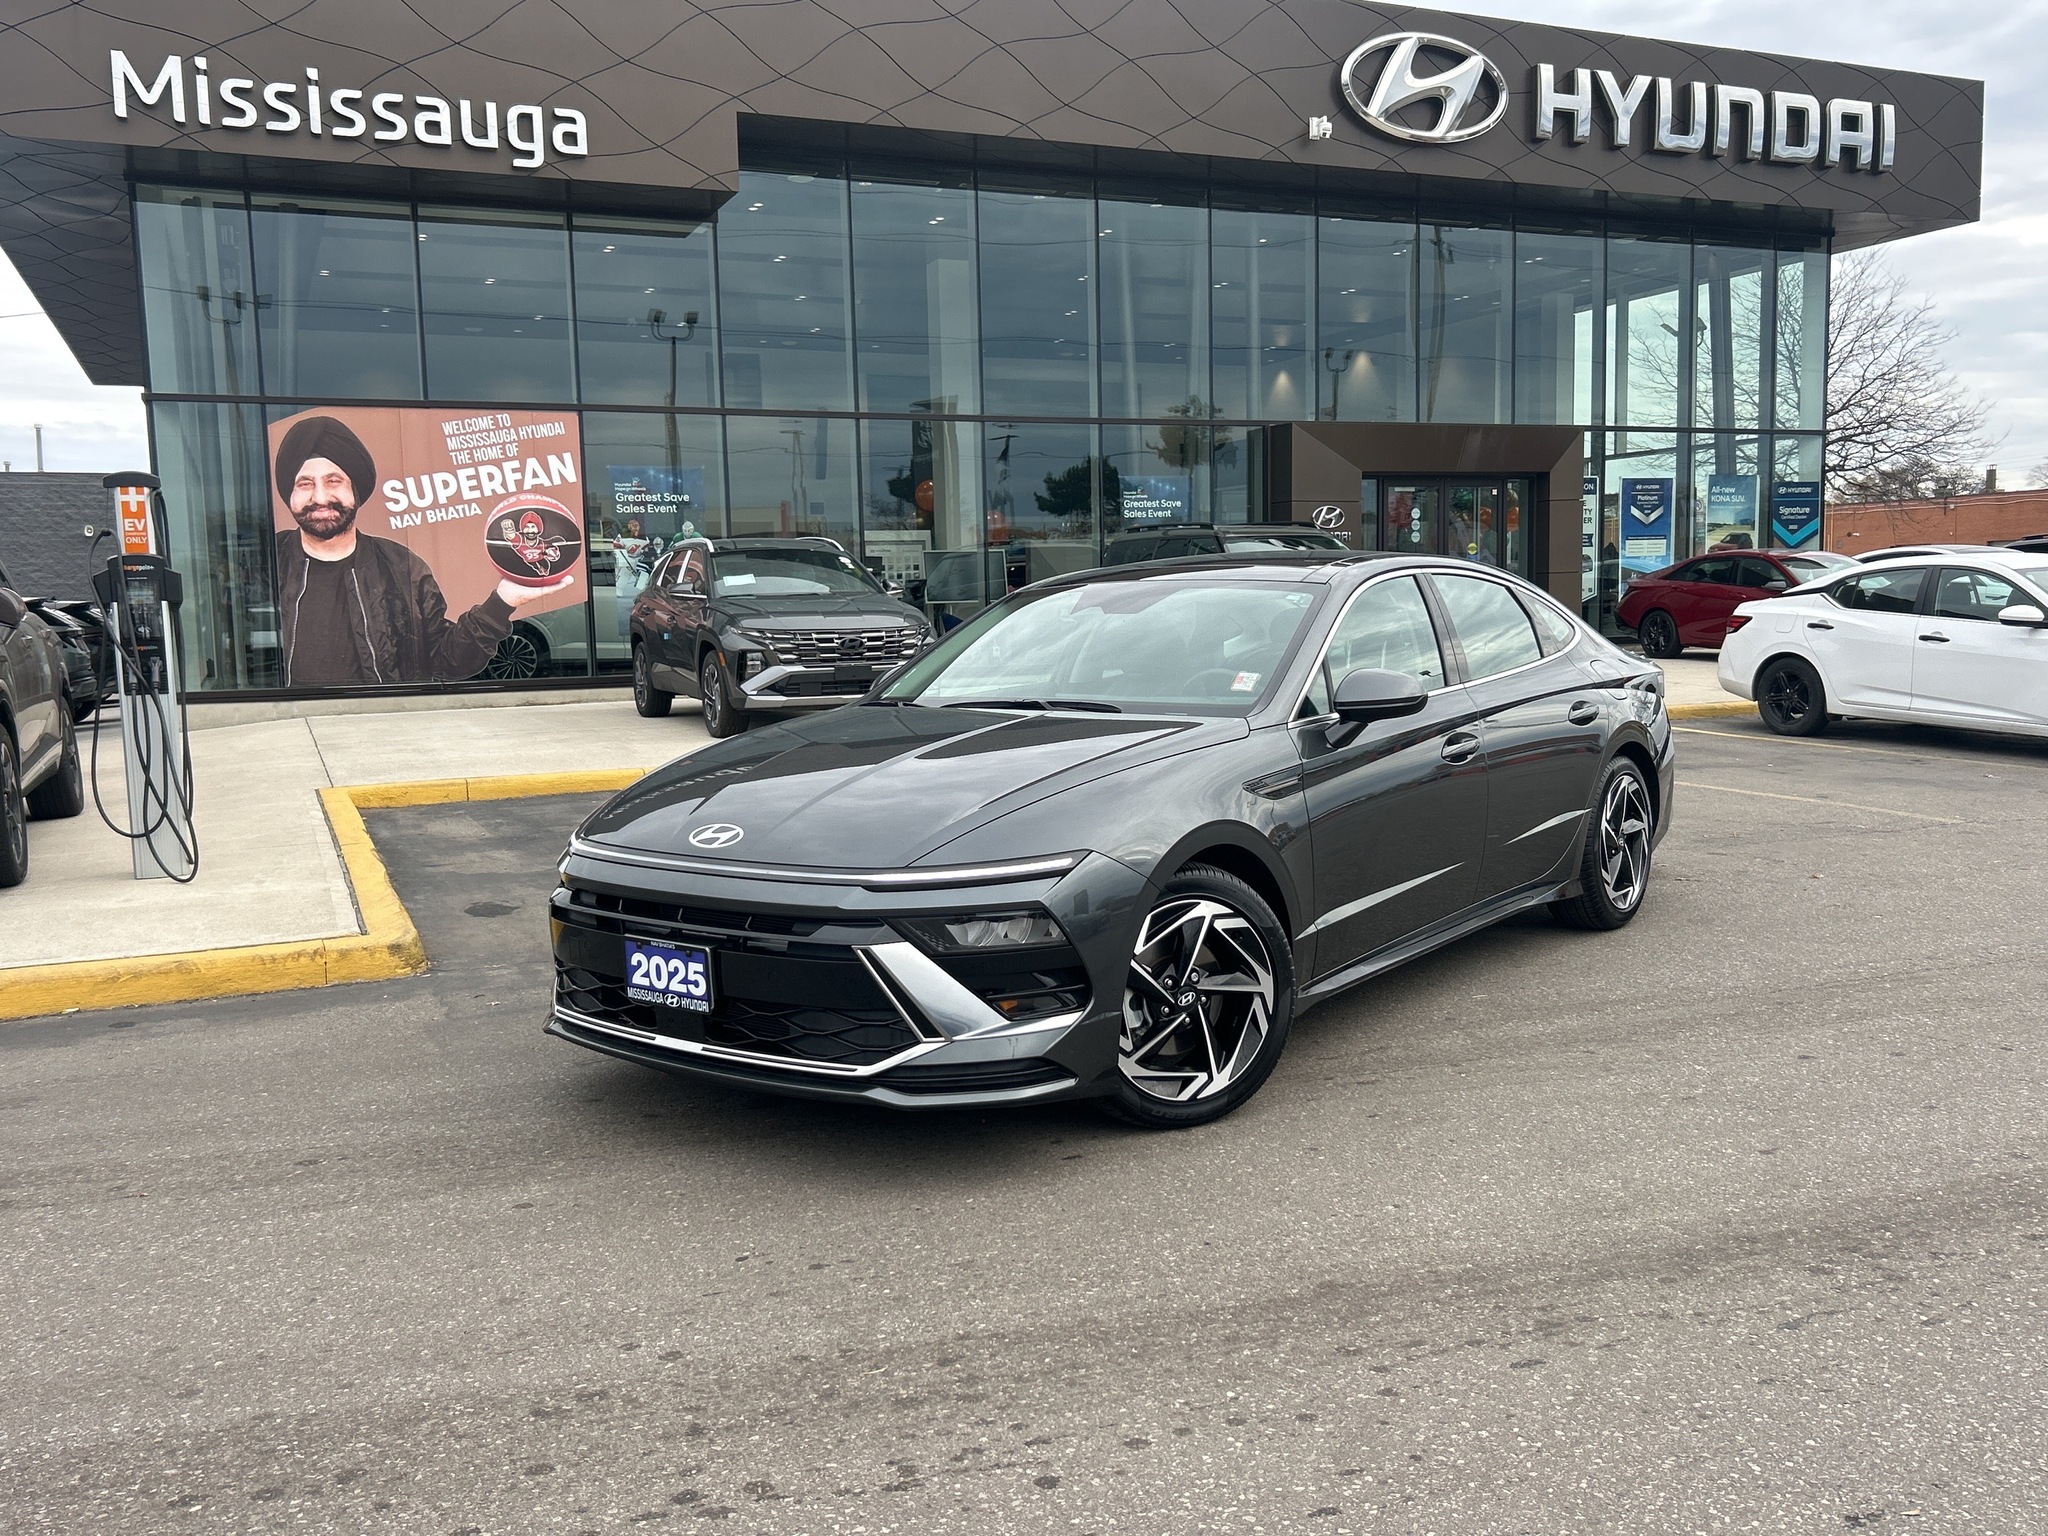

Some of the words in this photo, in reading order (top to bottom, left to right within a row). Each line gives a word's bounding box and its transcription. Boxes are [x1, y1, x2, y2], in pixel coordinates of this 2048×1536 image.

[110, 49, 589, 169] Mississauga
[1535, 62, 1896, 173] HYUNDAI
[442, 416, 496, 436] WELCOME
[497, 413, 512, 428] TO
[446, 429, 518, 451] MISSISSAUGA
[519, 421, 565, 440] HYUNDAI
[449, 450, 472, 466] THE
[474, 446, 503, 463] HOME
[506, 443, 519, 457] OF
[382, 452, 578, 513] SUPERFAN
[1711, 485, 1735, 493] All-new
[615, 492, 661, 502] Greatest
[663, 492, 690, 502] Save
[1123, 499, 1160, 508] Greatest
[1160, 499, 1182, 508] Save
[1711, 494, 1730, 502] KONA
[616, 503, 645, 513] Sales
[647, 503, 677, 513] Event
[1123, 509, 1147, 518] Sales
[1148, 509, 1171, 518] Event
[1779, 506, 1810, 515] Signature
[389, 512, 422, 530] NAV
[426, 502, 482, 524] BHATIA
[124, 518, 146, 531] EV
[125, 536, 147, 544] ONLY
[526, 552, 540, 560] 95
[631, 952, 707, 997] 2025
[627, 986, 664, 1004] MISSISSAUGA
[681, 997, 709, 1013] HYUNDAI
